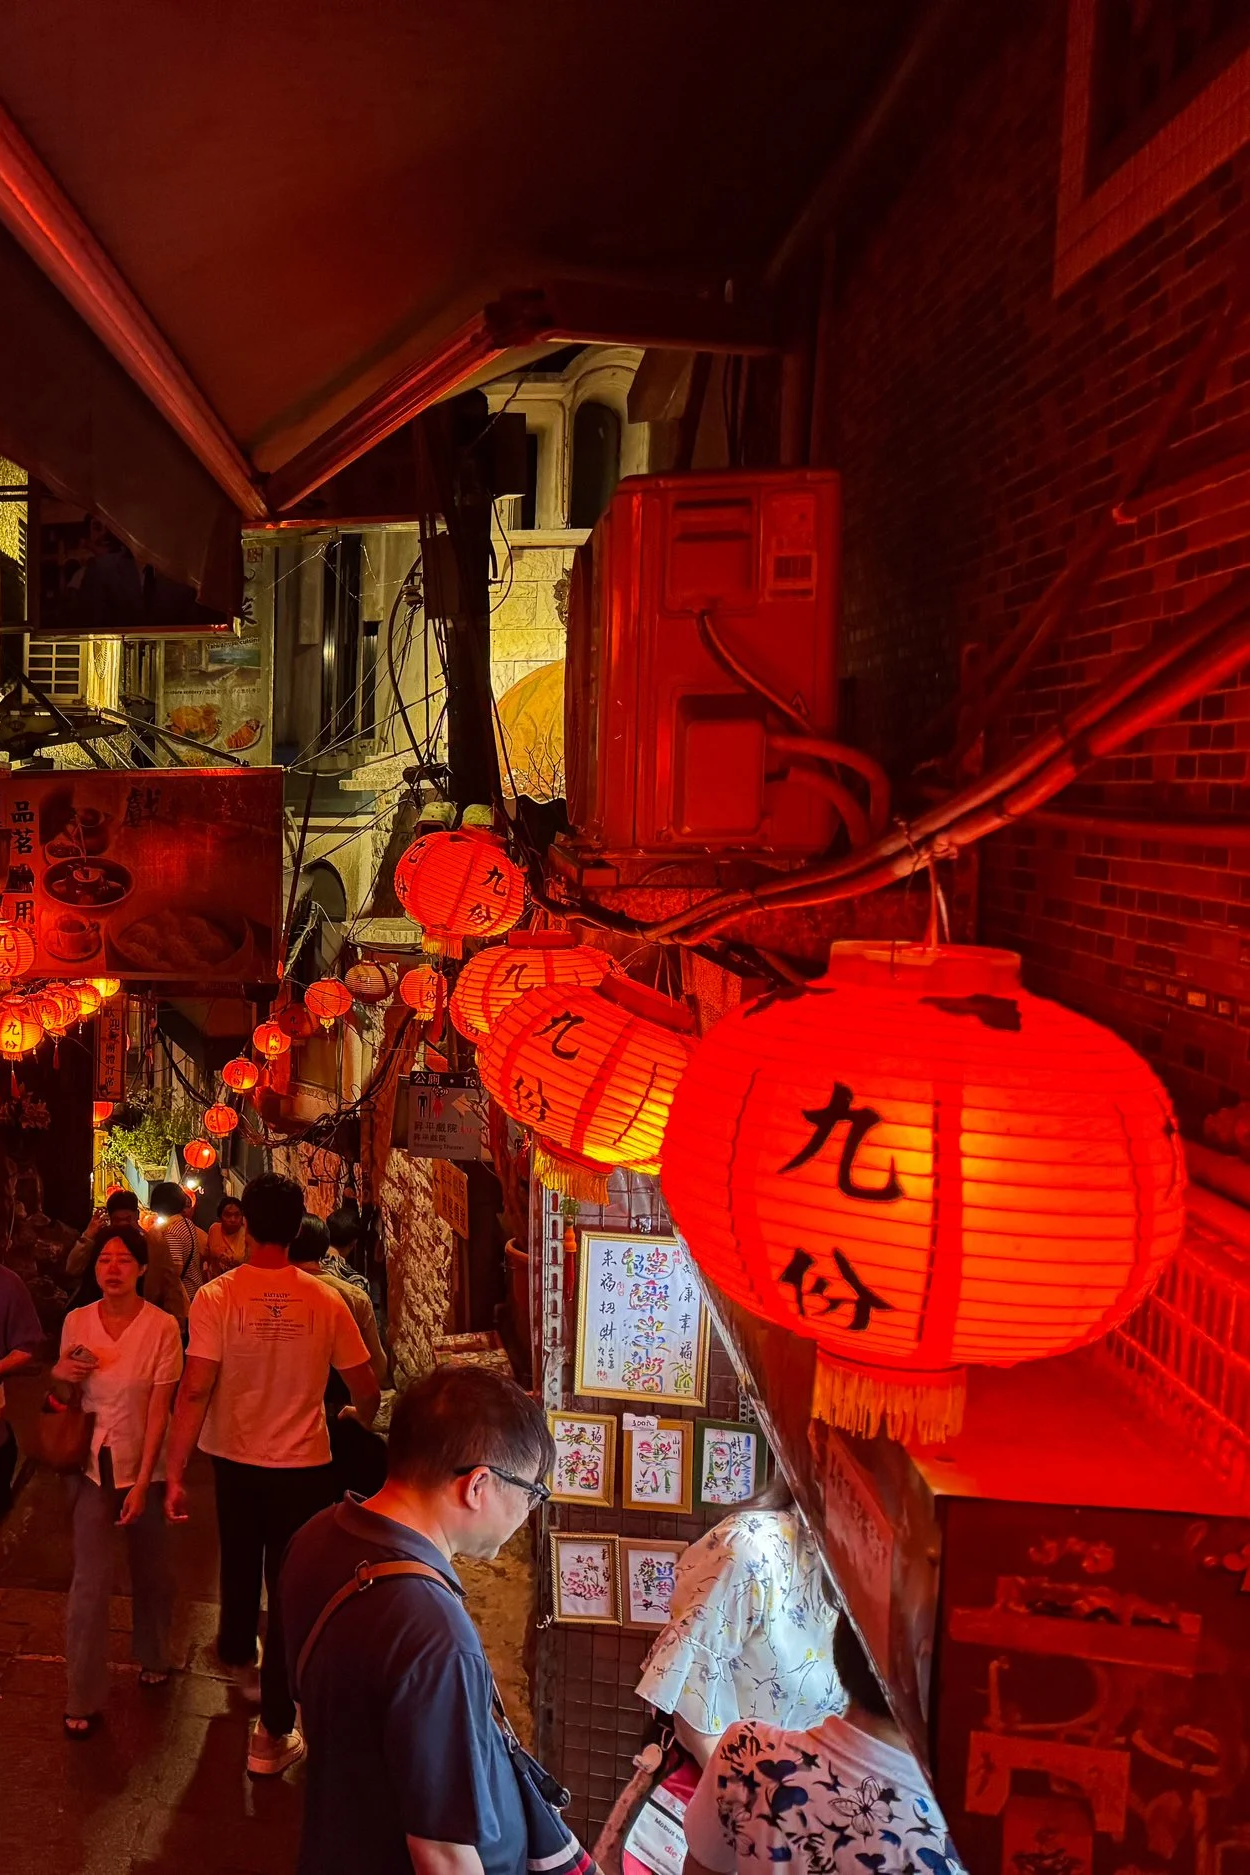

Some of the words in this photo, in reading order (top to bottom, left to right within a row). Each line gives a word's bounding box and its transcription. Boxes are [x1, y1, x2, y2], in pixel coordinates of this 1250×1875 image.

[467, 866, 508, 925] 九份
[426, 975, 438, 1002] 九份
[5, 1022, 20, 1049] 九份
[270, 1033, 280, 1053] 九份
[513, 1010, 586, 1122] 九份
[777, 1081, 906, 1332] 九份
